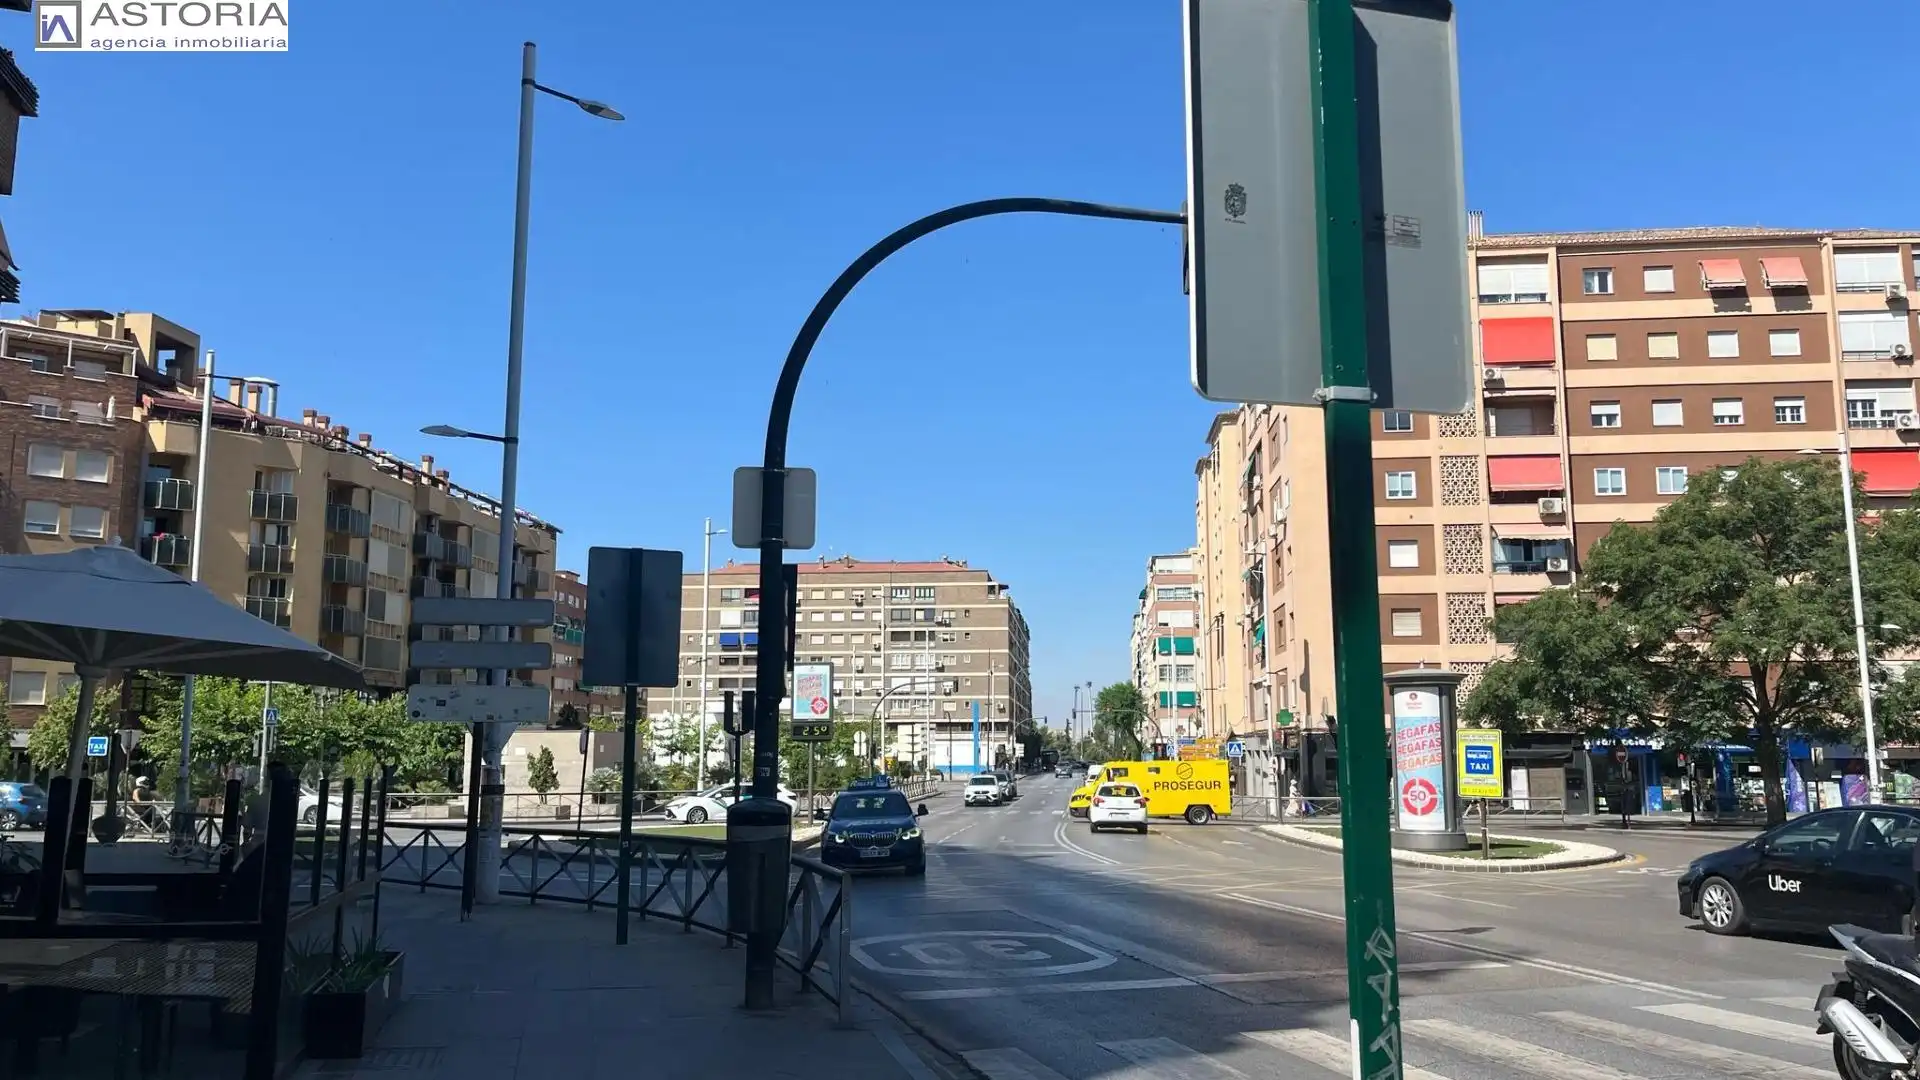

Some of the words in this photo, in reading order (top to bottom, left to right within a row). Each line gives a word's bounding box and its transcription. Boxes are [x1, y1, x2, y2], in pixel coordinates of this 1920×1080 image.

[1469, 762, 1490, 771] TAXI
[1153, 780, 1222, 791] PROSEGUR
[1410, 790, 1427, 801] 50
[1768, 874, 1802, 893] Uber
